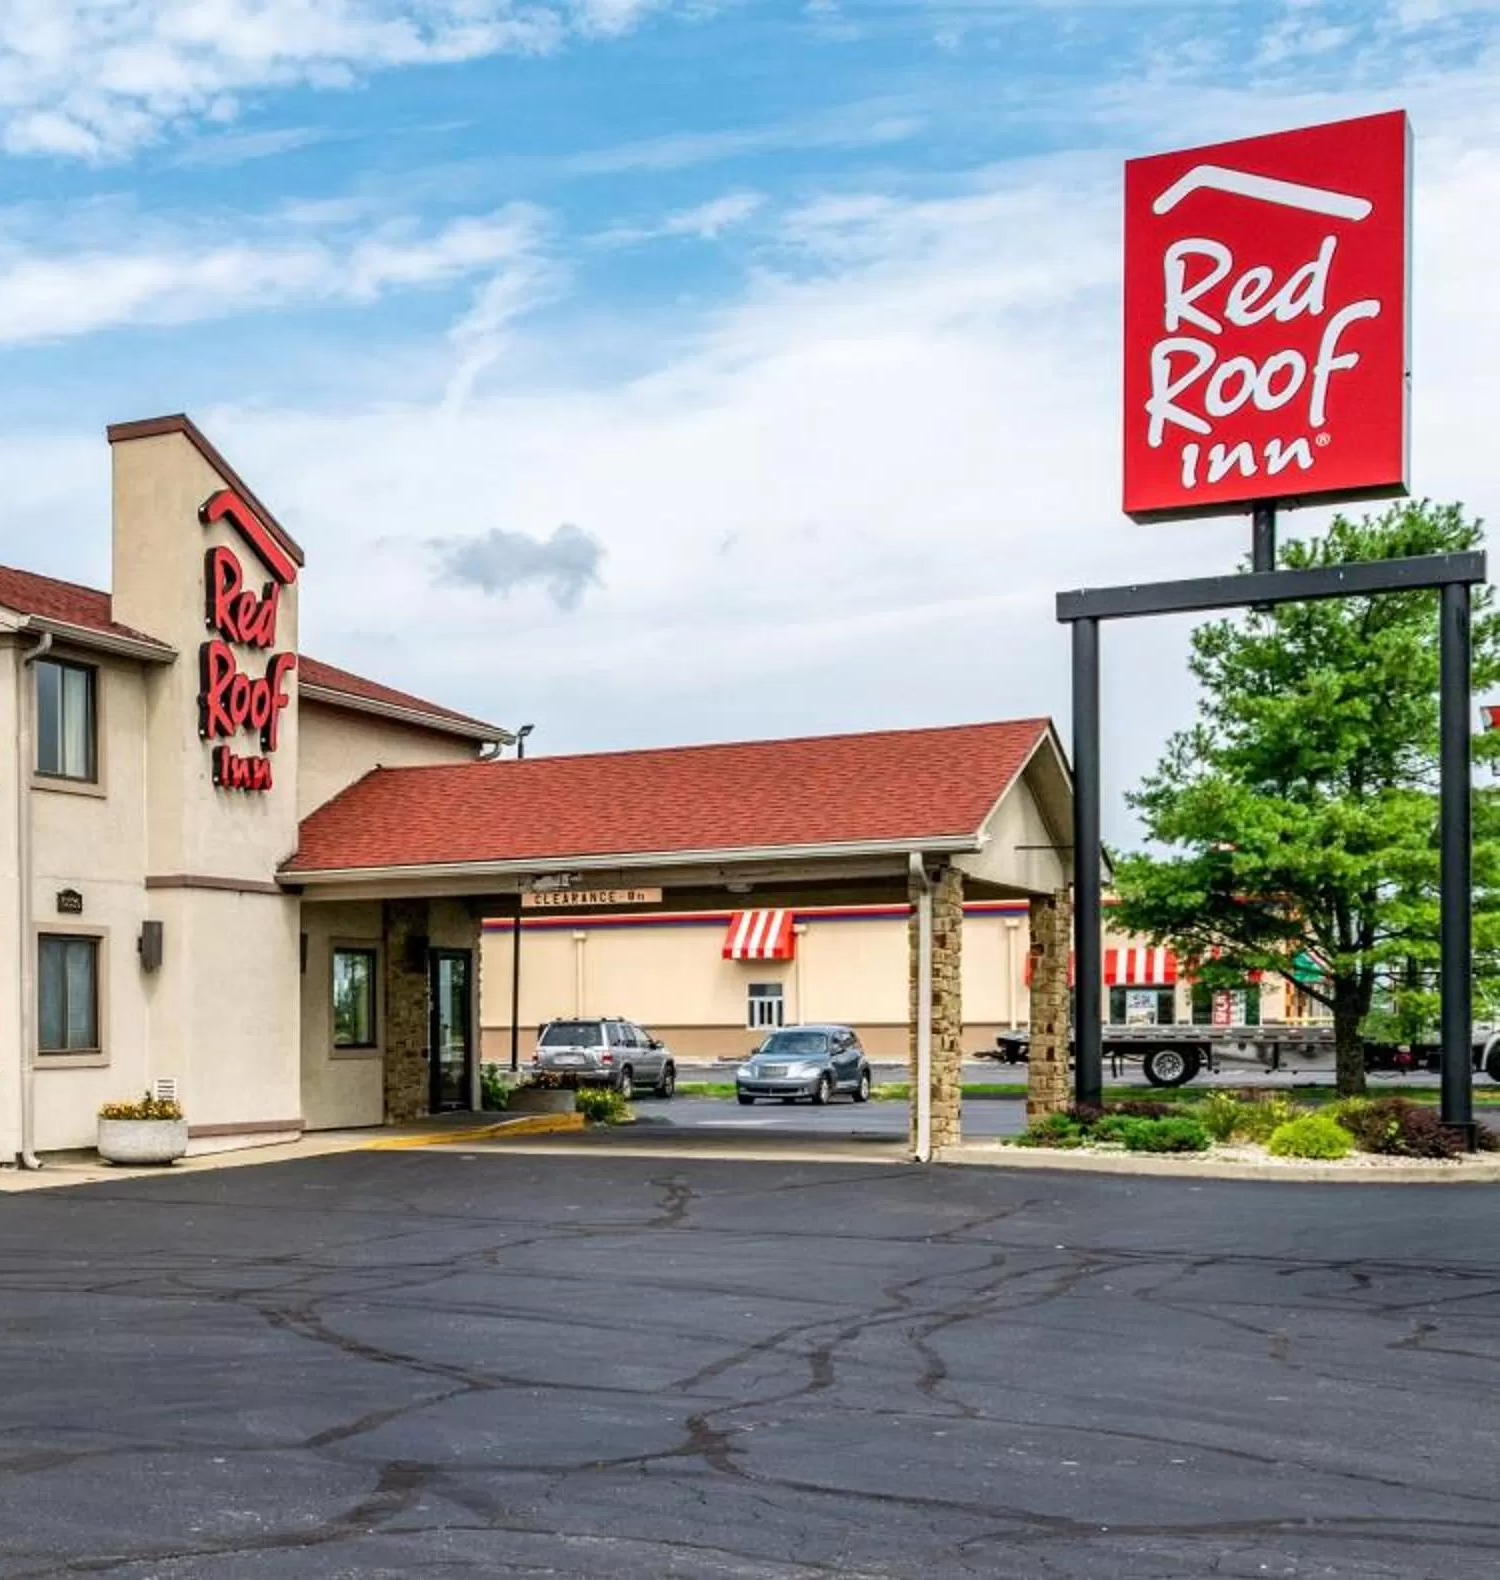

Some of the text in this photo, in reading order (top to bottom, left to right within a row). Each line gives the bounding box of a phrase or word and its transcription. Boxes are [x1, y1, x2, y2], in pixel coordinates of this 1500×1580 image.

[1164, 235, 1337, 335] Red
[1145, 299, 1381, 448] Roof
[204, 546, 280, 648] Red
[197, 640, 296, 752] Roof
[212, 746, 272, 790] Inn
[533, 891, 617, 905] CLEARANCE
